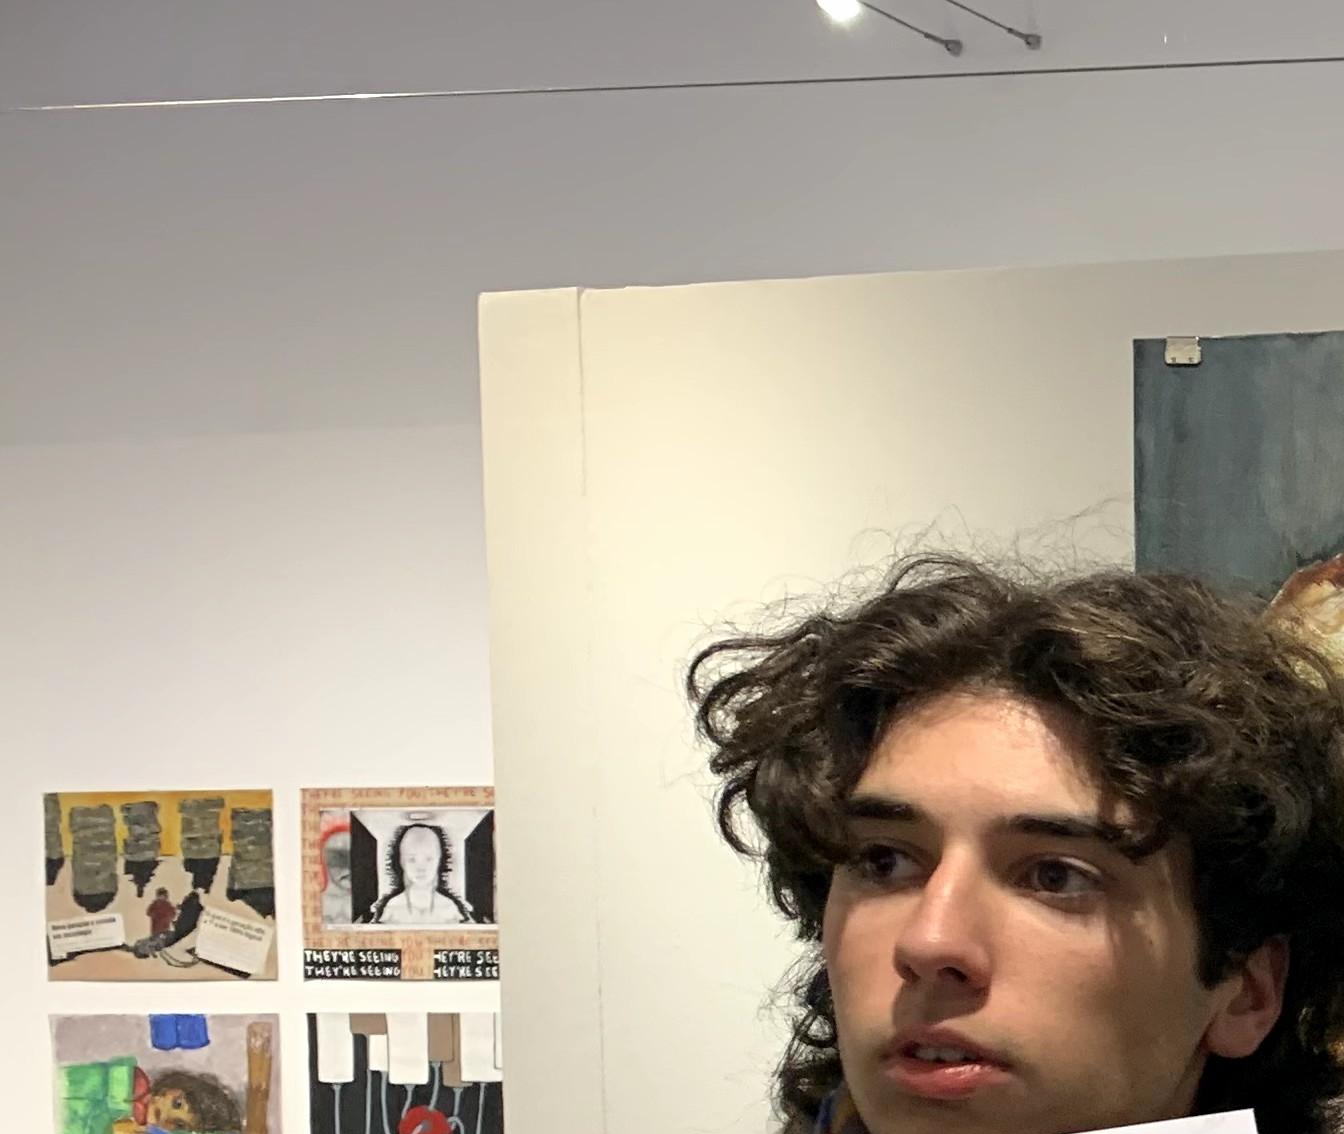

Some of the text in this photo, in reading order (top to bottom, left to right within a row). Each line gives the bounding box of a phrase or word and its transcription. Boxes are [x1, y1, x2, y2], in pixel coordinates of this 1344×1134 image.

[305, 950, 400, 964] THEY'RE SEEING
[305, 964, 401, 978] THEY'RE SEEING
